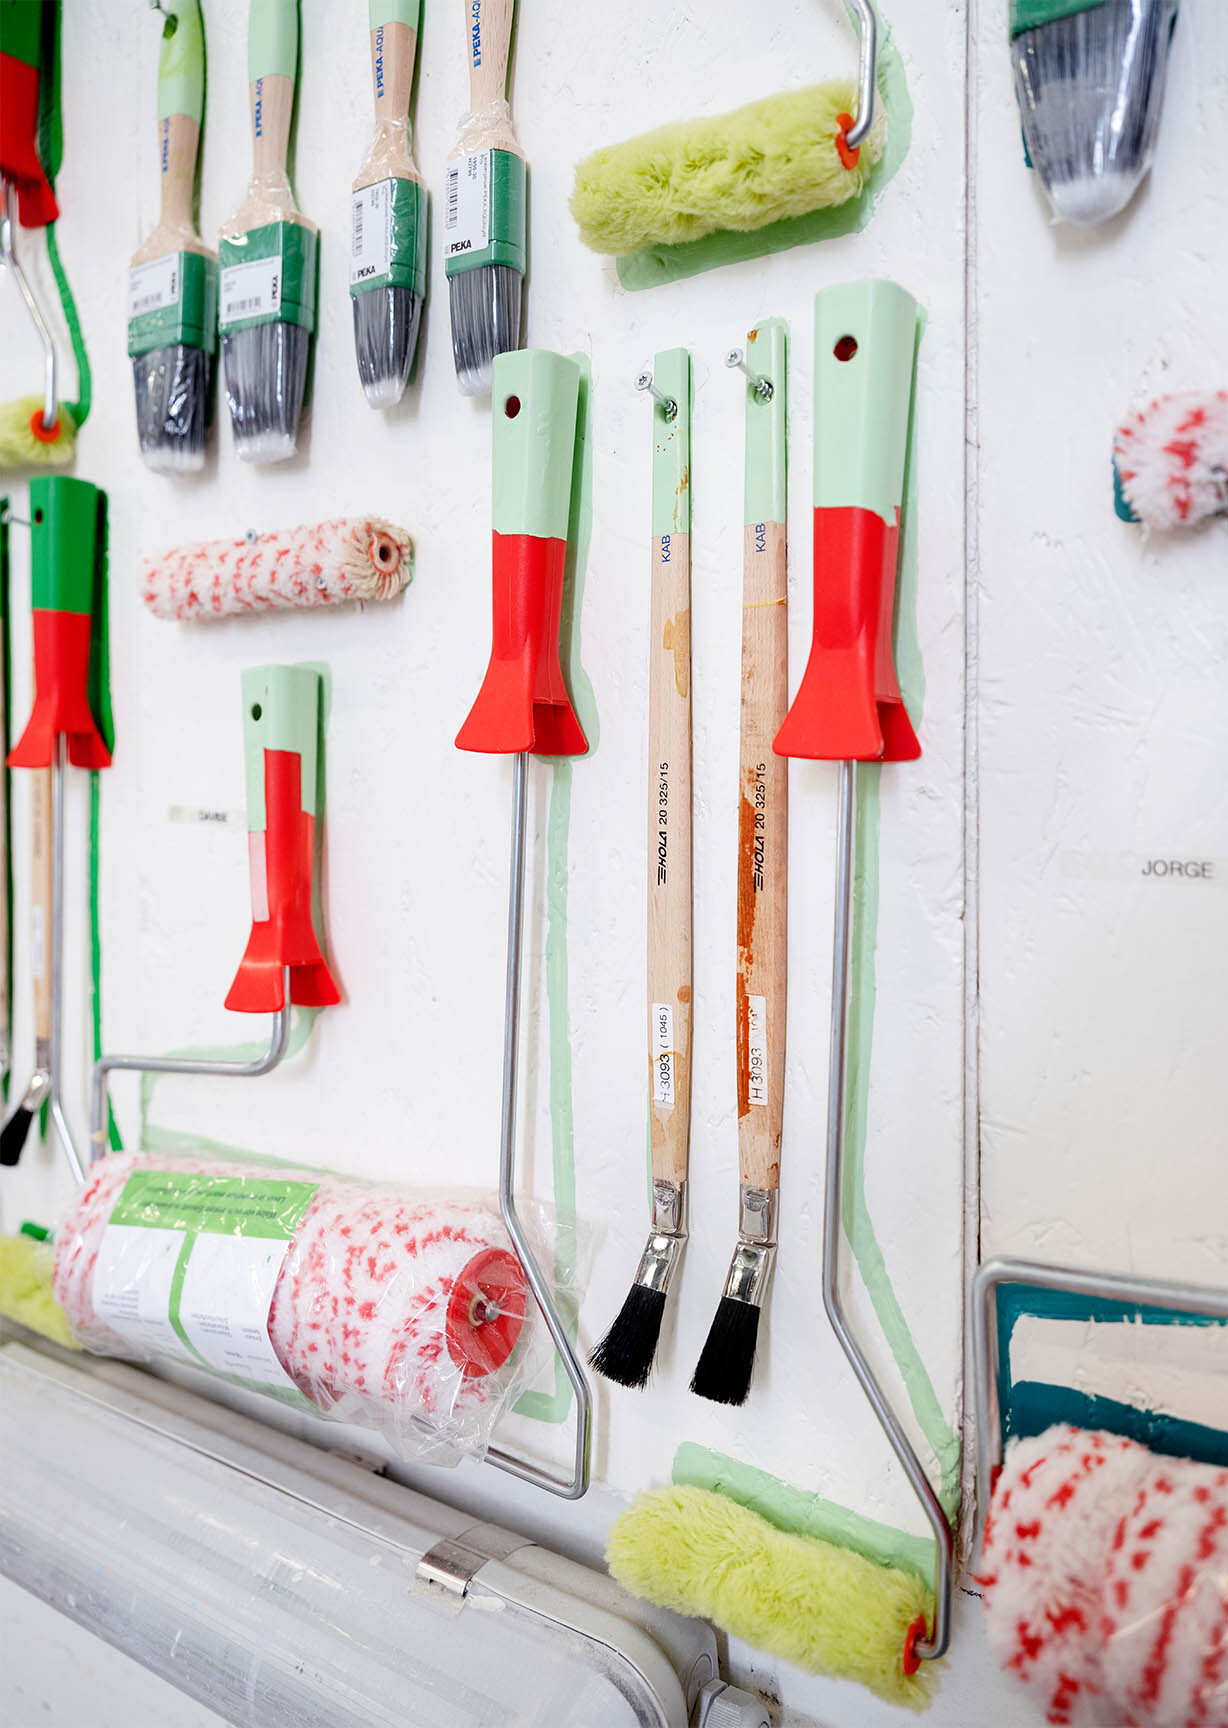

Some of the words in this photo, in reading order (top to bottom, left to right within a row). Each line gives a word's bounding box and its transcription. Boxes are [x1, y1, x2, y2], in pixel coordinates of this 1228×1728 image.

[451, 240, 472, 253] PEKA
[357, 265, 376, 279] PEKA
[661, 534, 671, 563] KAB
[755, 522, 767, 553] KAB
[659, 762, 669, 805] 325/15
[755, 763, 767, 808] 325/15
[659, 809, 668, 825] 20
[756, 813, 765, 829] 20
[1141, 859, 1214, 879] JORGE
[660, 1014, 668, 1038] 1045
[660, 1053, 670, 1089] 3093
[751, 1048, 763, 1084] 3093
[751, 1087, 762, 1099] H
